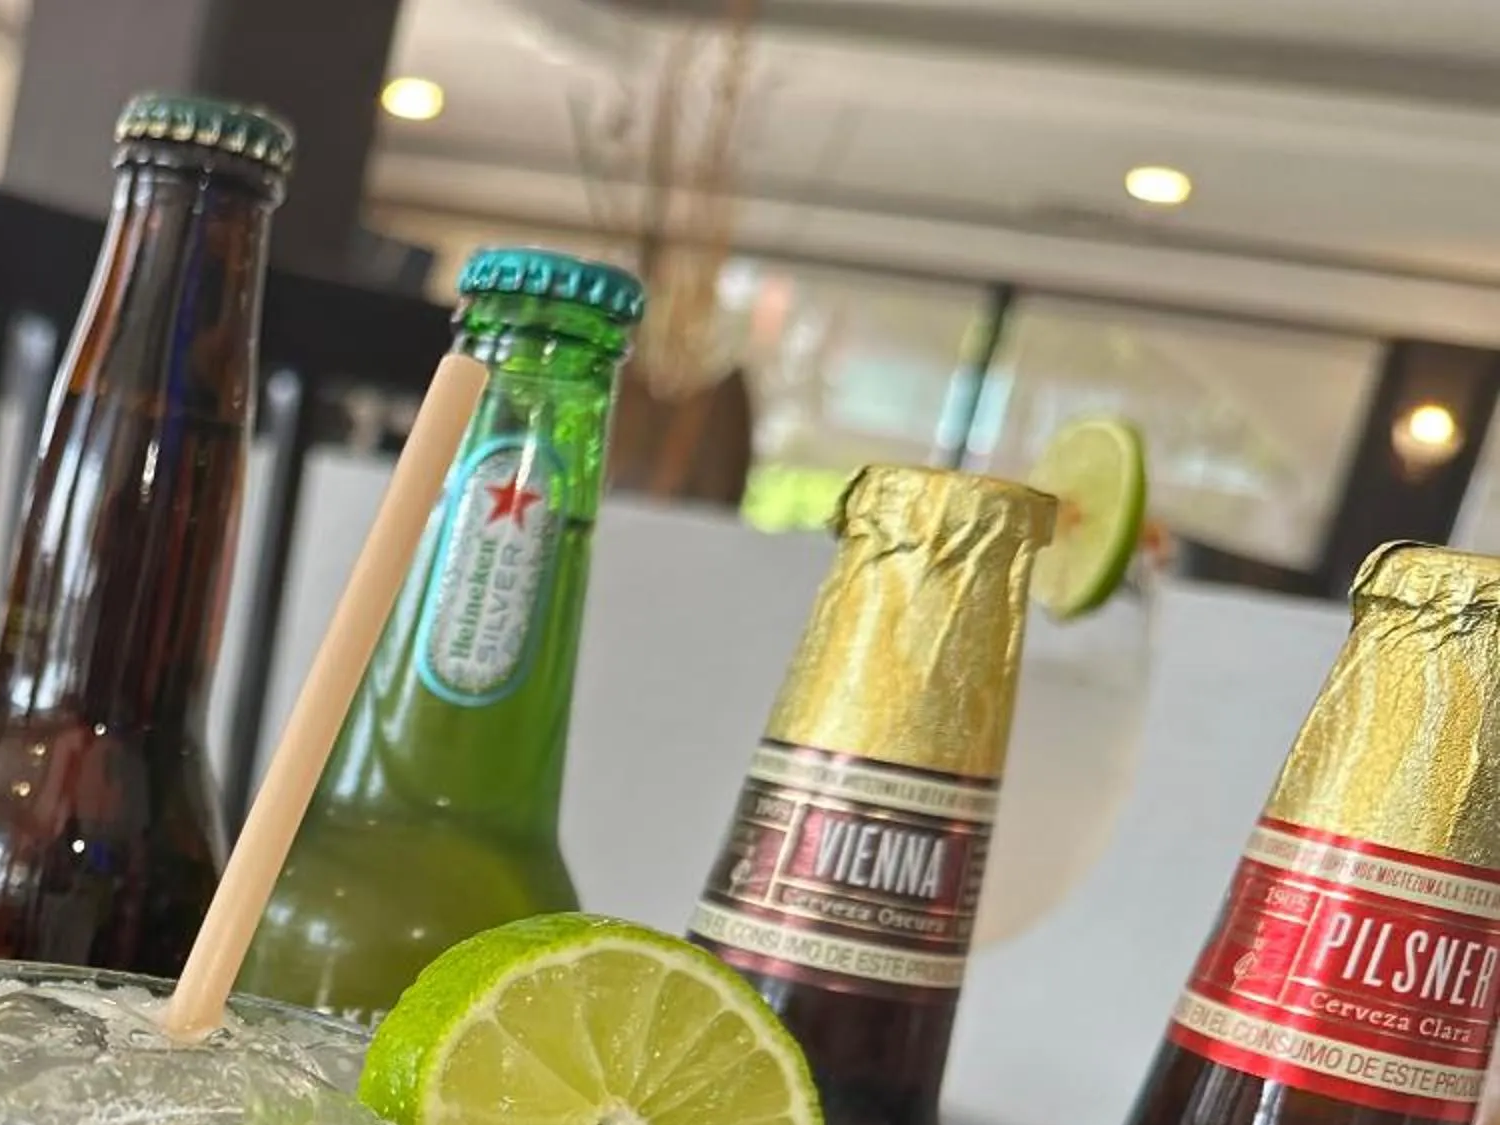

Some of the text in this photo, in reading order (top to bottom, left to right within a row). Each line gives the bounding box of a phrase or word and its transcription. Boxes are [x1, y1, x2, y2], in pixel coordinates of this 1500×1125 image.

[449, 539, 498, 659] Heineken
[476, 543, 522, 664] SILVER
[814, 816, 947, 899] VIENNA
[1312, 911, 1498, 1010] PILSNER
[1230, 1016, 1343, 1071] CONSUMO
[1345, 1051, 1380, 1079] DE
[1380, 1059, 1435, 1092] ESTE
[1309, 990, 1472, 1043] Cerveza Clara
